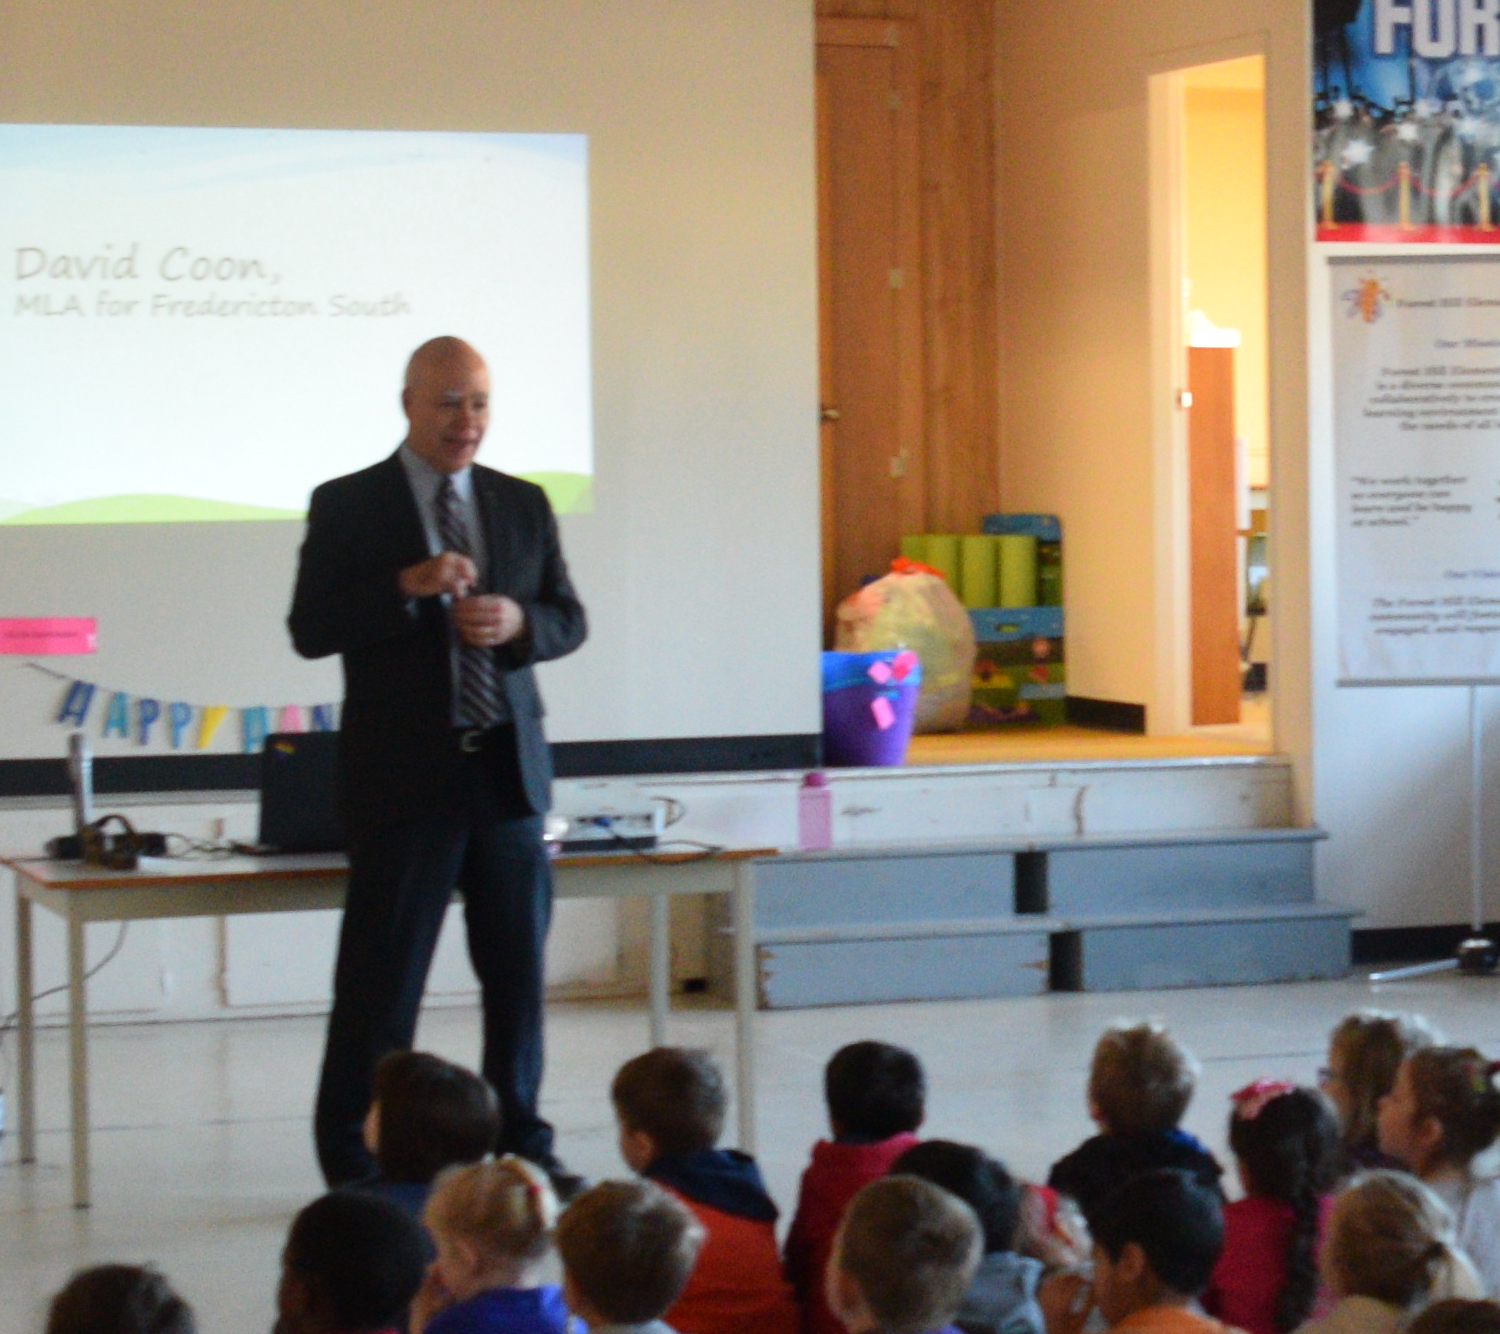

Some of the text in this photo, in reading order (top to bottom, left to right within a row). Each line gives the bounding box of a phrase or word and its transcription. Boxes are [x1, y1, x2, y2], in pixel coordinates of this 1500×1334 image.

[15, 242, 283, 285] David Coon,
[13, 289, 413, 318] MLA for Fredericton South
[56, 679, 229, 750] HAPPY
